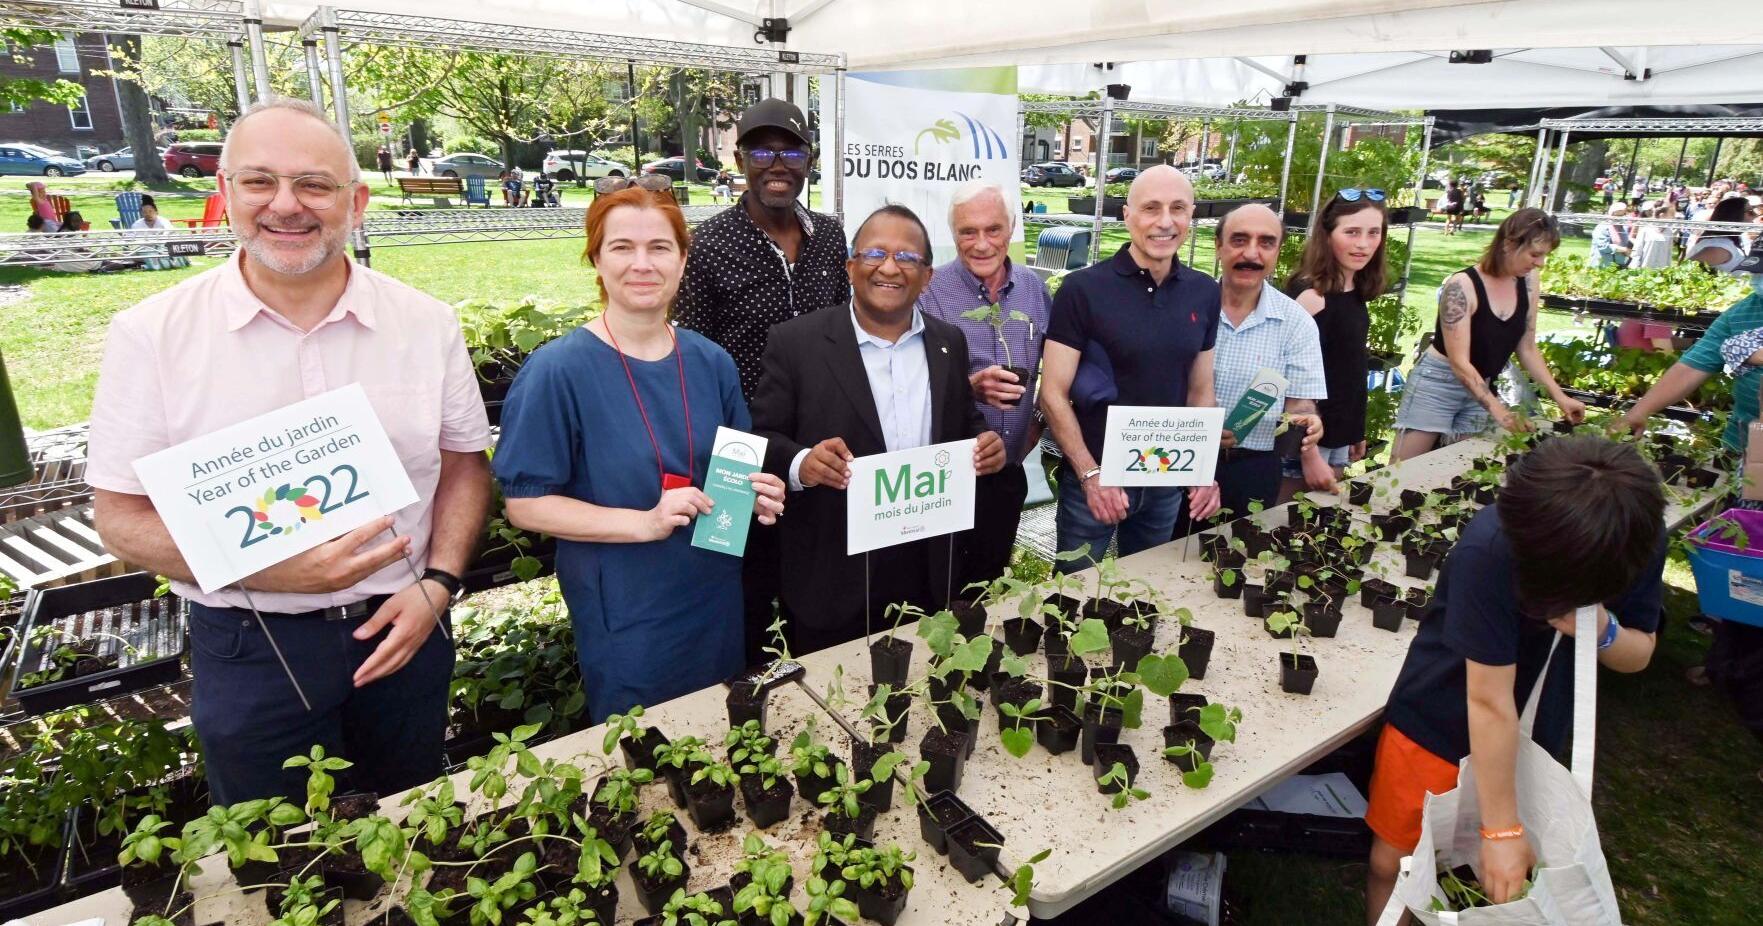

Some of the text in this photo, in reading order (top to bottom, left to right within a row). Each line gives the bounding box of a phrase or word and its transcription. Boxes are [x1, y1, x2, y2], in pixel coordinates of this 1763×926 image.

[864, 144, 904, 158] SERRES
[878, 160, 918, 180] DOS
[924, 162, 982, 182] BLANC
[172, 244, 199, 253] KLETON
[1128, 418, 1204, 429] Année du jardin
[191, 414, 339, 479] Année du jardin
[1121, 433, 1208, 442] Year of the Garden
[188, 431, 361, 505] Year of the Garden
[1126, 447, 1196, 473] 2022
[716, 467, 731, 477] MON
[875, 460, 947, 506] Mai
[224, 464, 370, 549] 2022
[874, 497, 952, 521] mois du jardin
